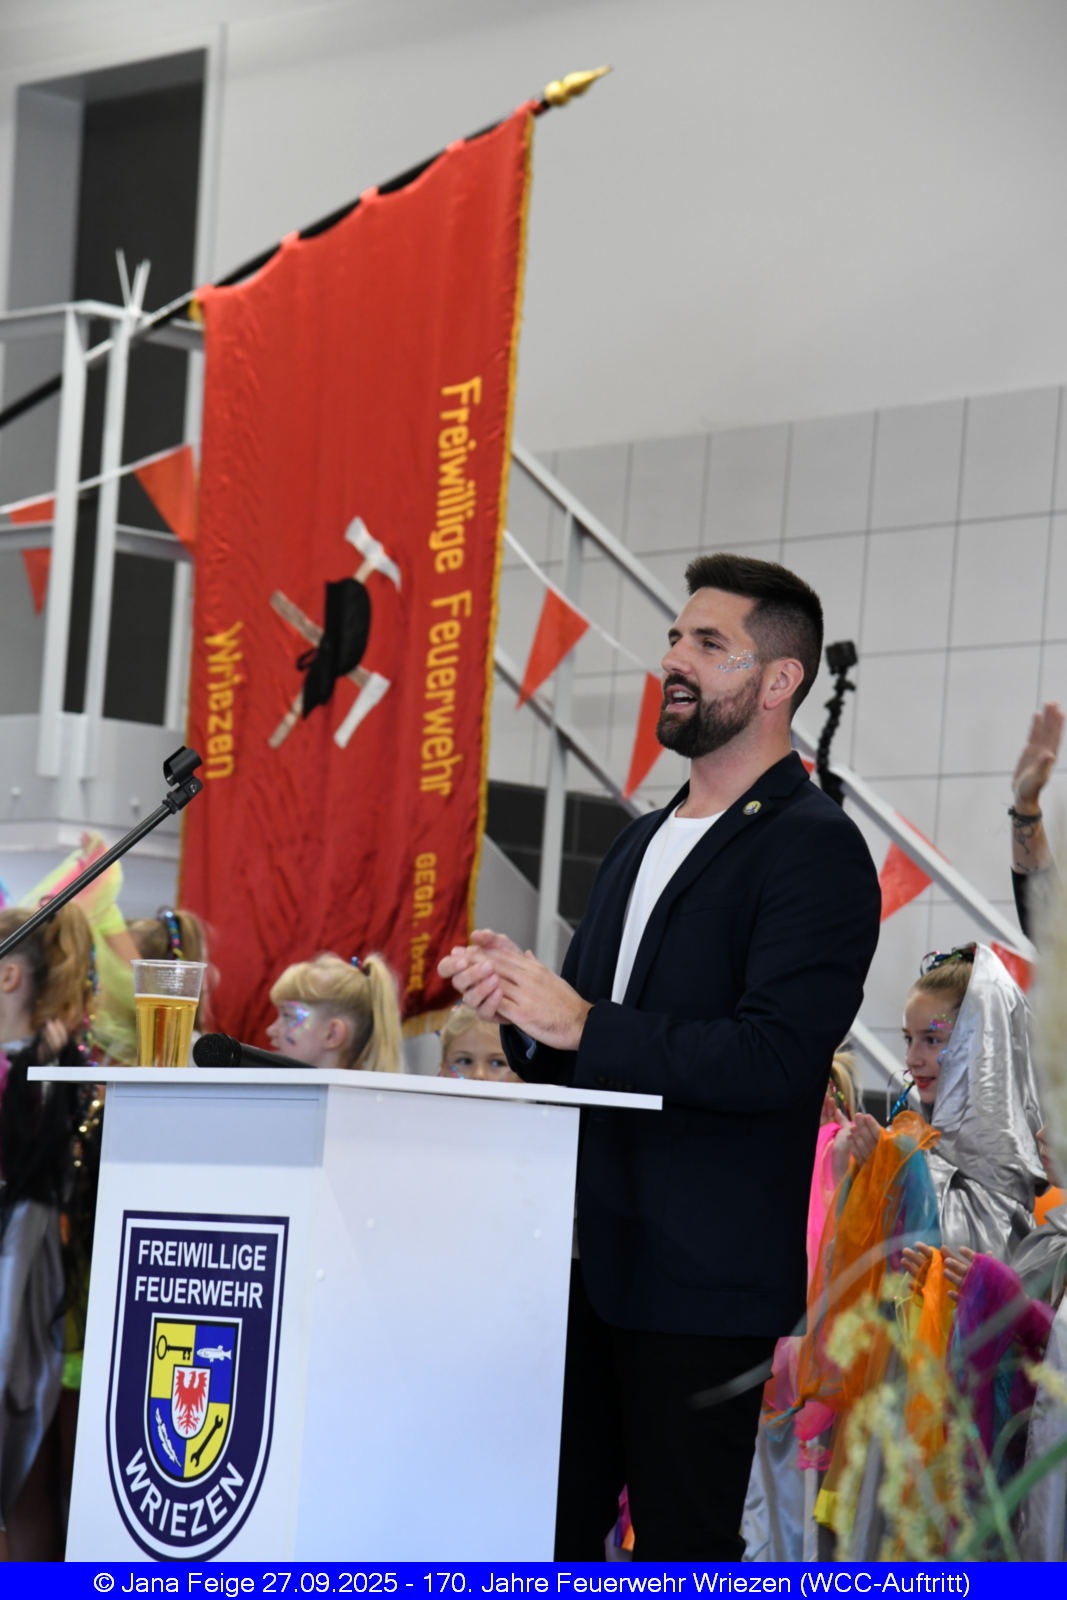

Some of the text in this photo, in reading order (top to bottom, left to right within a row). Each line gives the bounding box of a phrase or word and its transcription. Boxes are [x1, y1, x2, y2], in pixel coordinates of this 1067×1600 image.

[419, 375, 482, 797] Freiwillige Feuerwehr
[204, 621, 244, 780] Wriezen
[134, 1275, 264, 1309] FEUERWEHR
[137, 1239, 268, 1272] FREIWILLIGE
[125, 1447, 245, 1538] WRIEZEN
